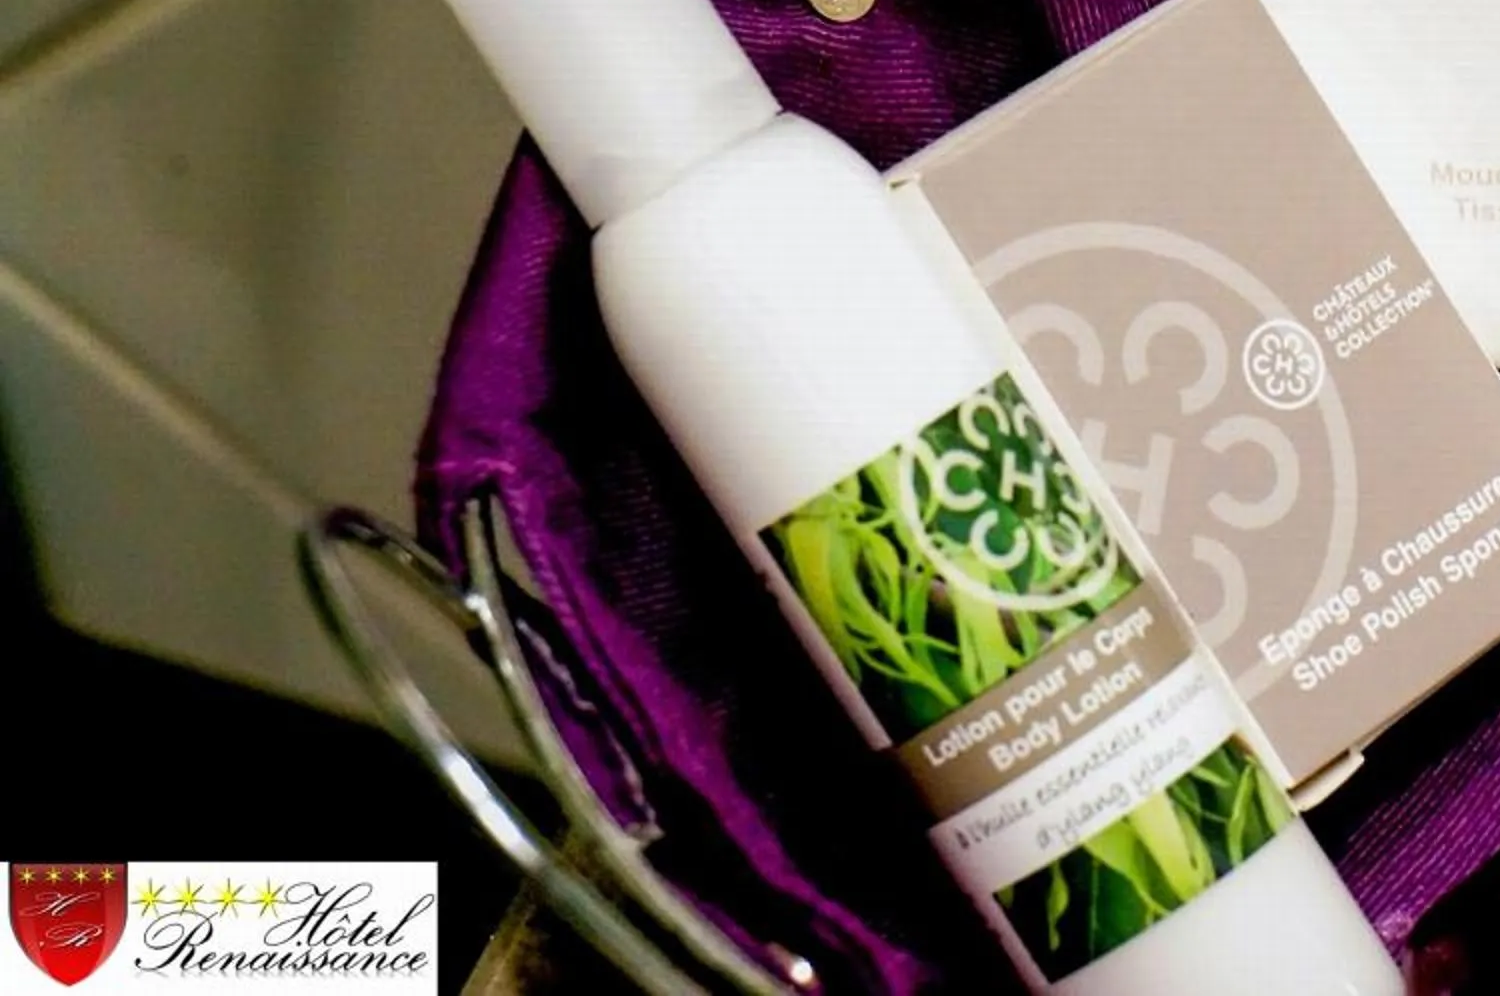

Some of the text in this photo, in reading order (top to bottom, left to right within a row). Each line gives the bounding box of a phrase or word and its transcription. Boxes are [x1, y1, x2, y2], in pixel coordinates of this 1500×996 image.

[1258, 587, 1361, 666] Eponge
[1361, 565, 1384, 594] à
[1293, 631, 1364, 691] Shoe
[1362, 571, 1443, 642] Polish
[923, 708, 1005, 767] Lotion
[1004, 666, 1069, 724] pour
[1068, 648, 1097, 676] le
[987, 716, 1062, 773] Body
[1060, 660, 1143, 726] Lotion
